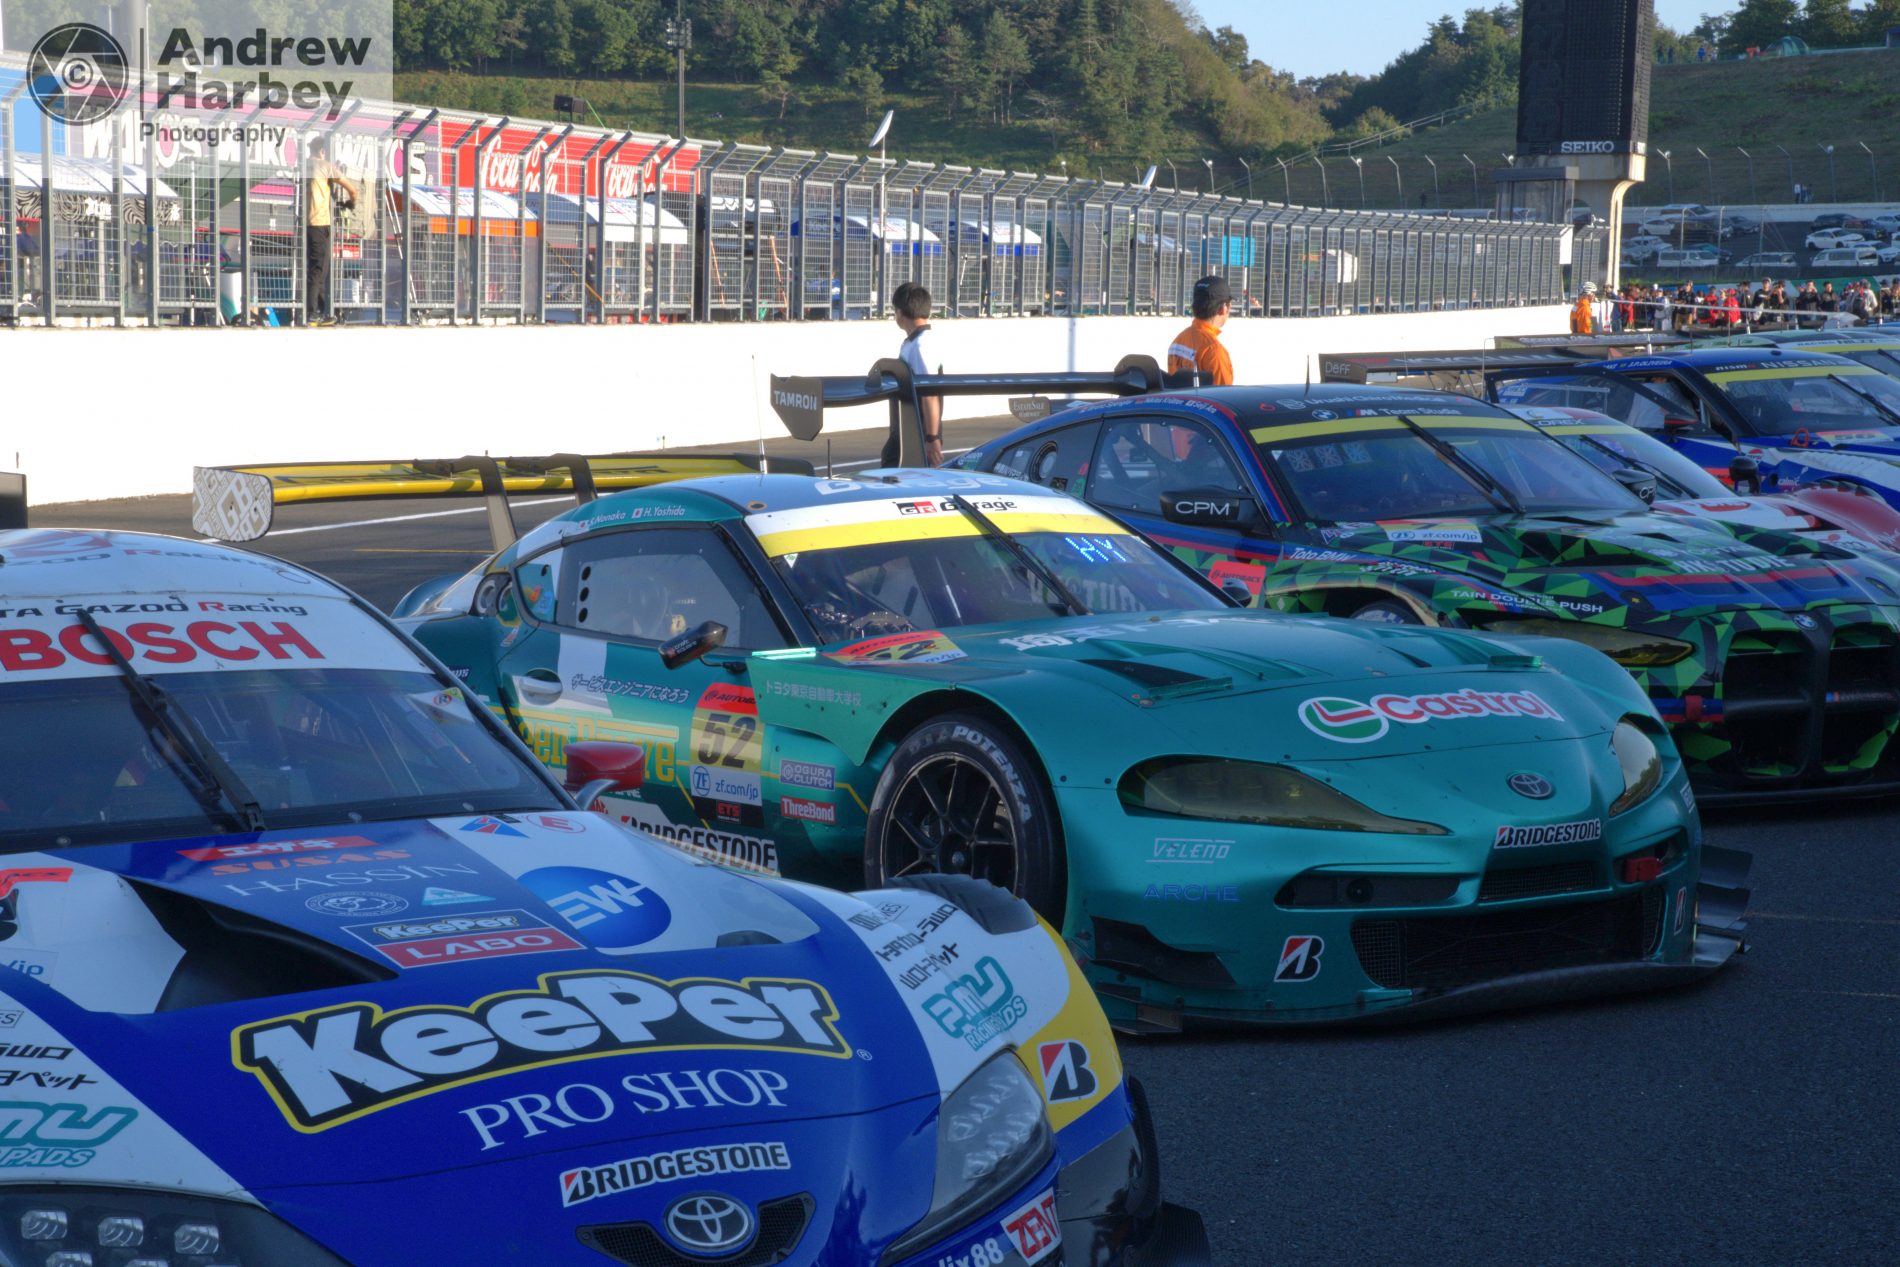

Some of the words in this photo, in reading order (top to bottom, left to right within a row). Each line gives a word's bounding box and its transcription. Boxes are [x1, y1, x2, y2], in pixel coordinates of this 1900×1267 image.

[1560, 140, 1614, 153] SEIKO
[774, 390, 817, 411] TAMRON
[901, 505, 937, 515] GR
[940, 499, 1018, 512] Grage
[1175, 501, 1230, 516] CPM
[1318, 550, 1358, 563] BMW
[198, 601, 309, 617] Racing
[1450, 590, 1486, 599] TAIN
[1490, 593, 1557, 608] DOUBLE
[1559, 602, 1604, 613] PUSH
[0, 620, 326, 672] BOSCH
[1375, 689, 1564, 722] Castrol
[697, 713, 756, 769] 52
[793, 774, 833, 789] CLUTCH
[794, 765, 833, 778] OGURA
[952, 725, 1033, 824] POTENZA
[715, 779, 759, 801] zf.com/jp
[717, 801, 741, 817] ETS
[781, 797, 835, 821] ThreeBond
[1497, 819, 1601, 847] BRIDGESTONE
[1143, 883, 1241, 902] ARCHE
[377, 915, 517, 940] KeePer
[406, 934, 553, 960] LABO
[252, 975, 838, 1117] KeePer
[459, 1083, 615, 1152] PRO
[621, 1068, 789, 1114] SHOP
[563, 1143, 790, 1206] BRIDGESTONE
[1006, 1195, 1059, 1259] ZENT
